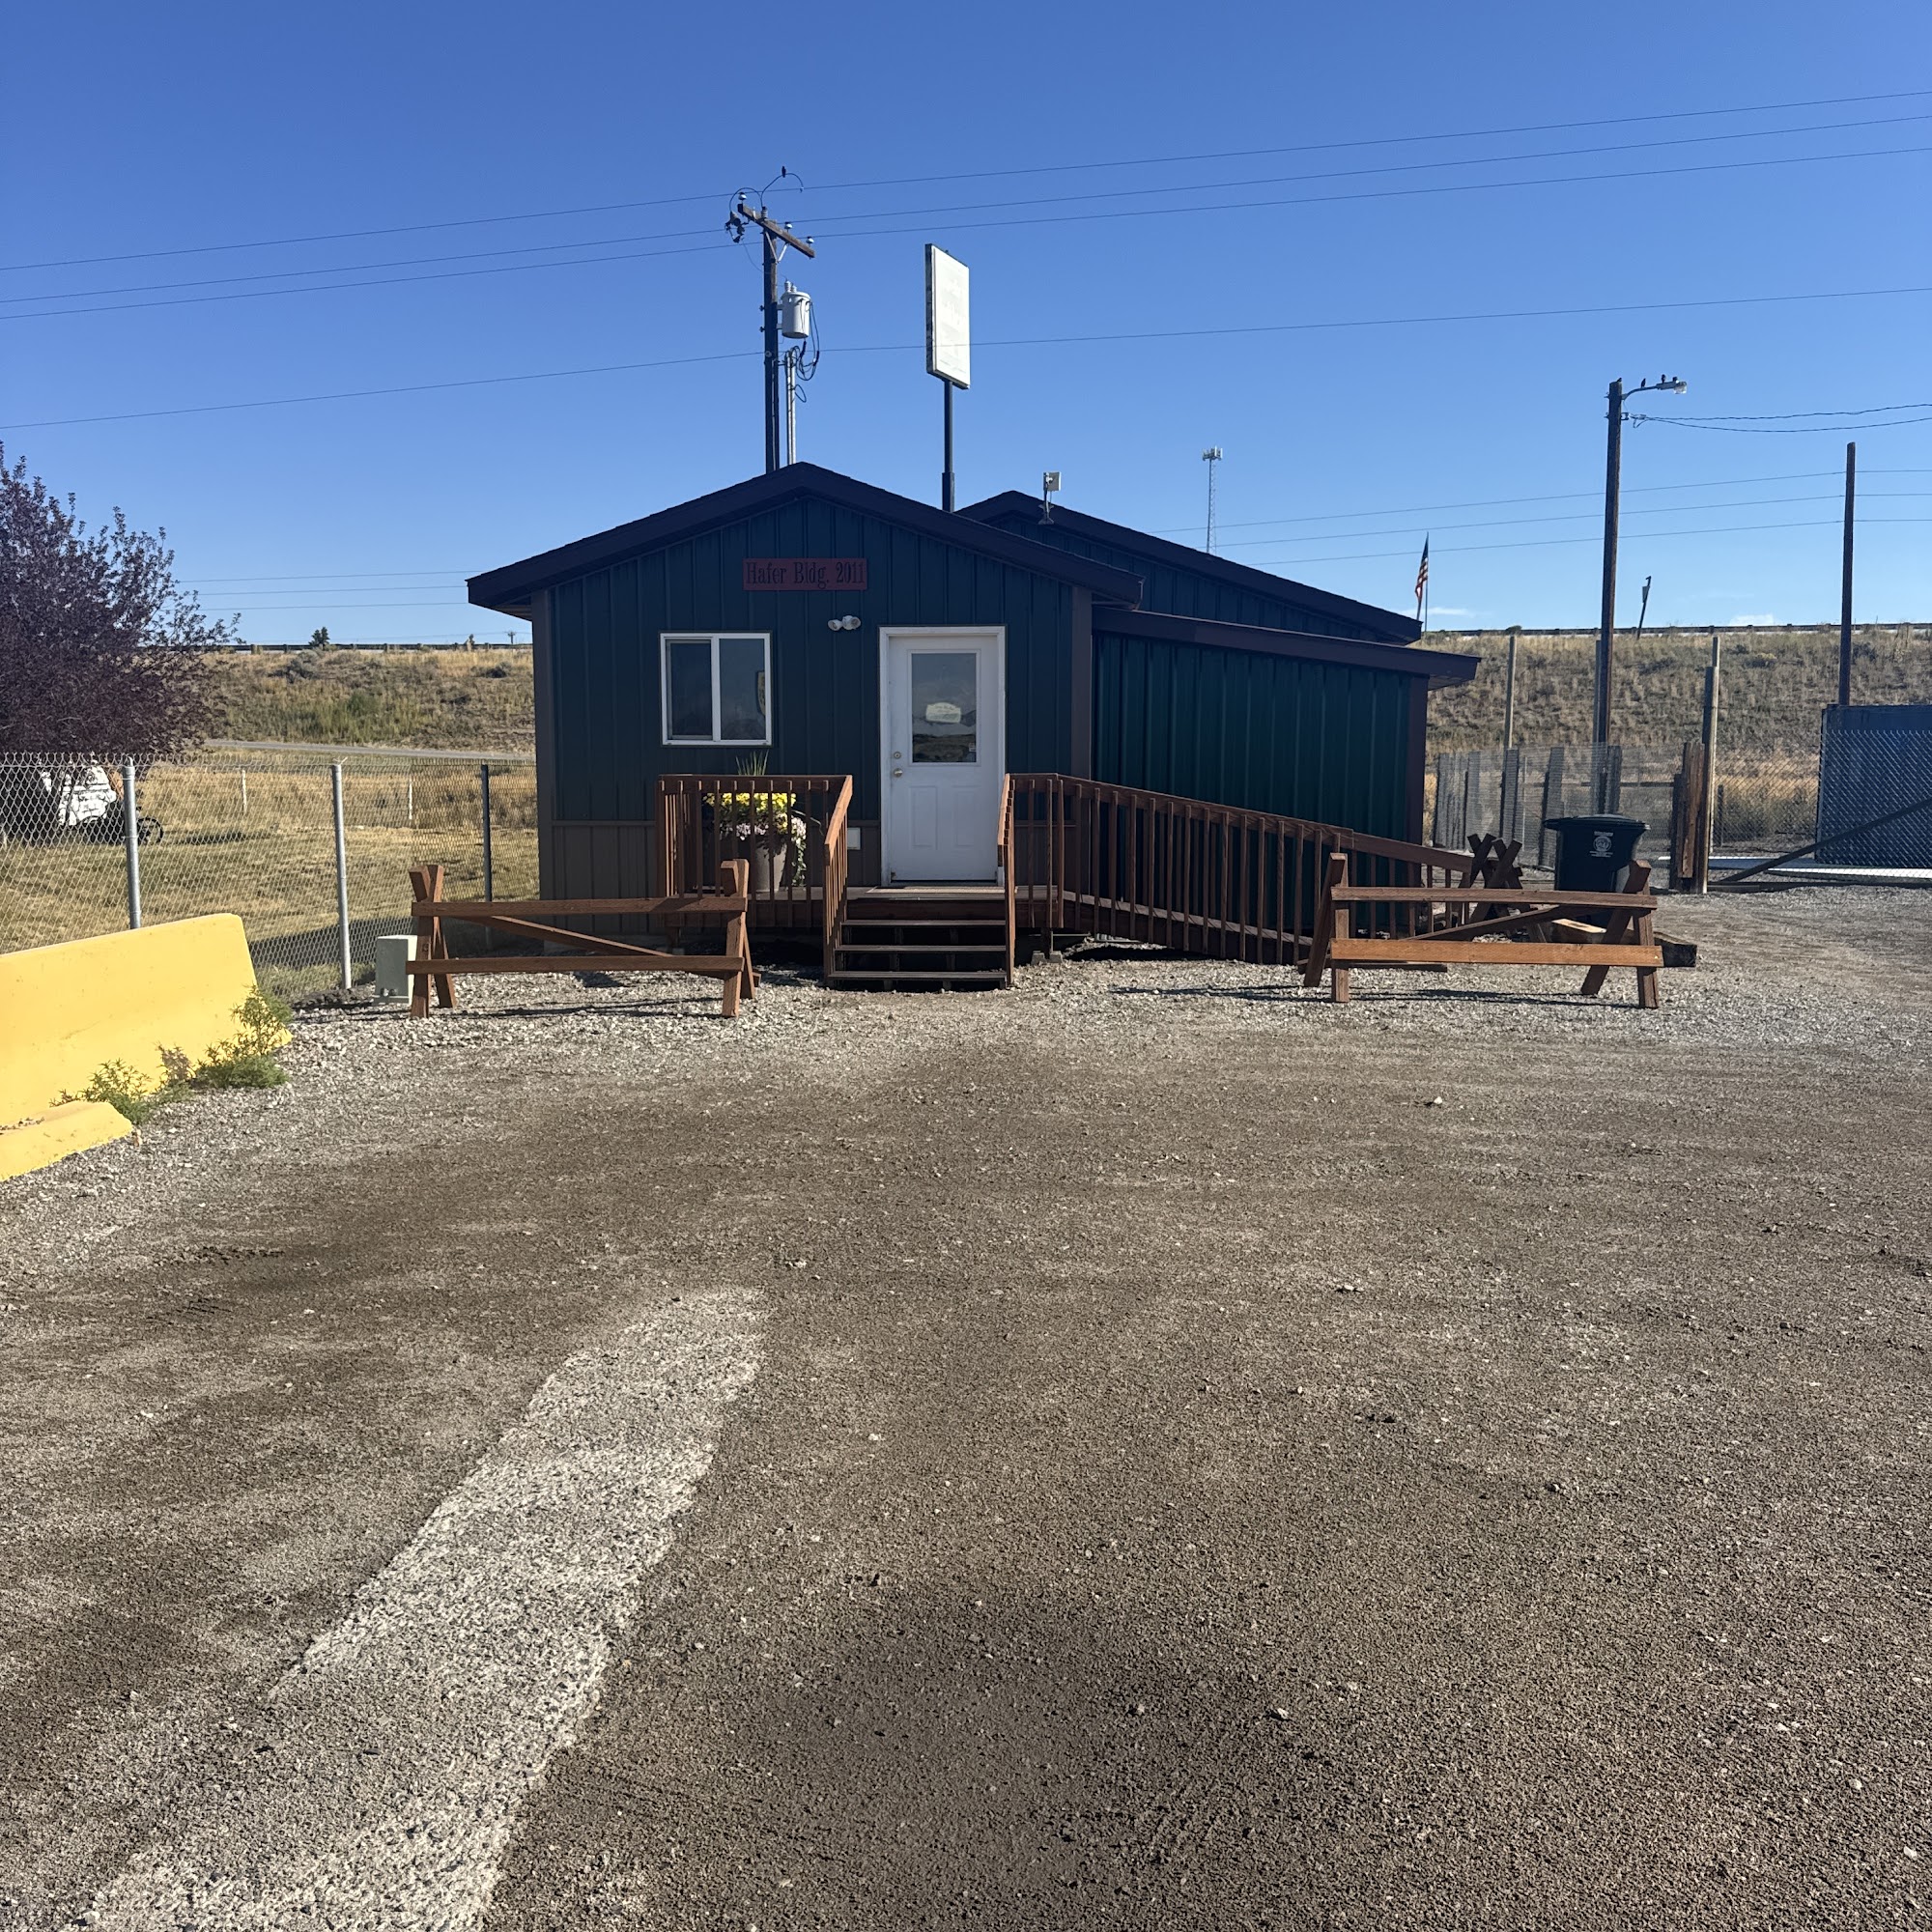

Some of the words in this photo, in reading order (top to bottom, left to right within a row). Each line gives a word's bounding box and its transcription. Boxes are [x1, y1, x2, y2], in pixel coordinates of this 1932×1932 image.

[746, 561, 786, 583] Hafer
[793, 561, 829, 589] Bldg.
[836, 561, 865, 583] 2011
